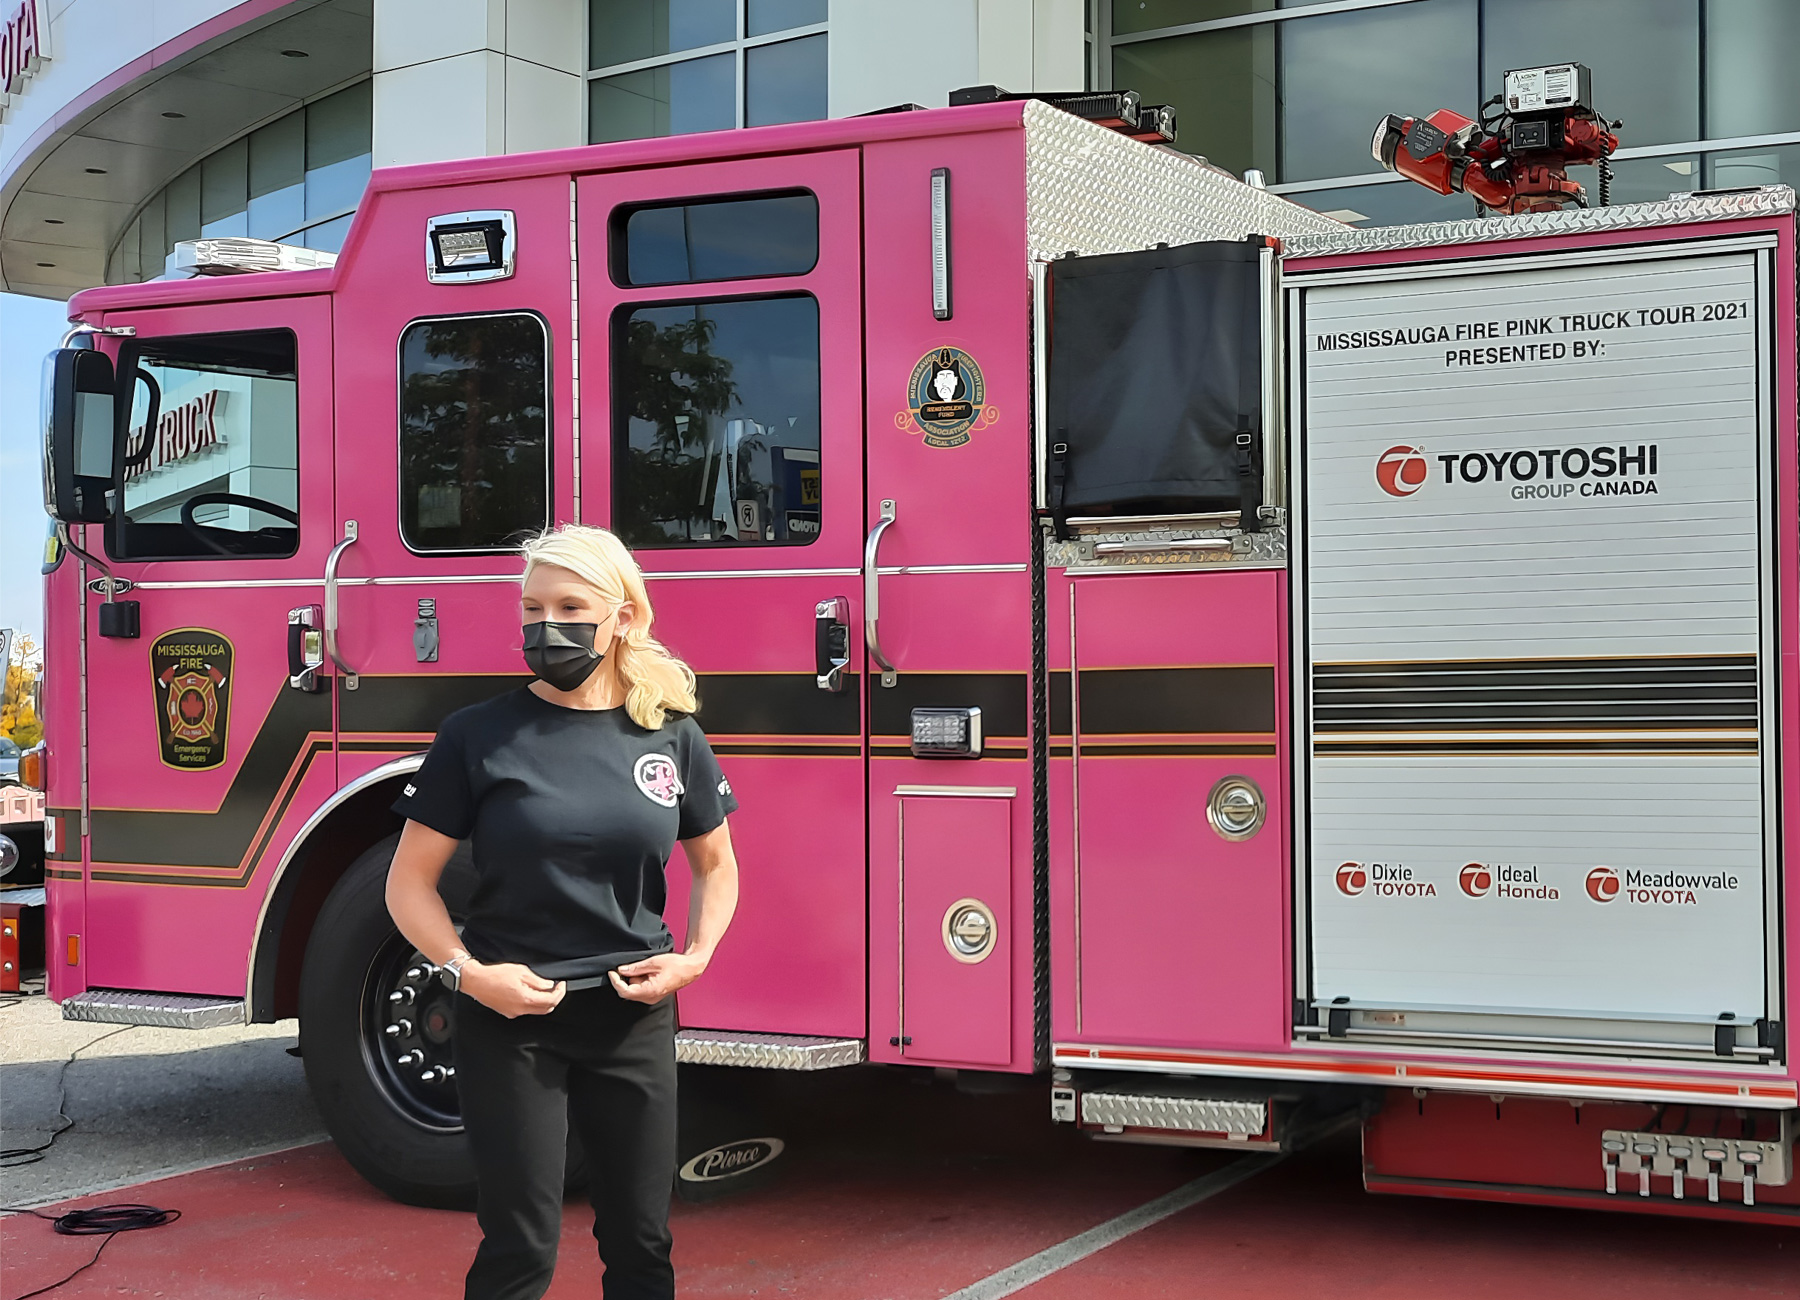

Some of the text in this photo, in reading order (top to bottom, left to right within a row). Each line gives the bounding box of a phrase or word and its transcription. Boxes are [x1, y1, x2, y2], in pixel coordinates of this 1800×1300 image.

[1317, 302, 1748, 351] MISSISSAUGA FIRE PINK TRUCK TOUR 2021
[1446, 340, 1606, 367] PRESENTED BY:
[924, 420, 970, 436] ASSOCIATION
[927, 437, 949, 446] LOCAL
[1438, 445, 1658, 484] TOYOTOSHI
[1511, 480, 1659, 500] GROUP CANADA
[157, 644, 226, 656] MISSISSAUGA
[180, 658, 204, 669] FIRE
[174, 745, 211, 754] Emergency
[179, 754, 207, 763] Services
[1372, 864, 1413, 881] Dixie
[1497, 865, 1539, 883] Ideal
[1626, 869, 1739, 890] Meadowvale
[1373, 883, 1437, 897] TOYOTA
[1497, 884, 1560, 900] Honda
[1626, 889, 1697, 904] TOYOTA
[702, 1147, 759, 1177] Pierce
